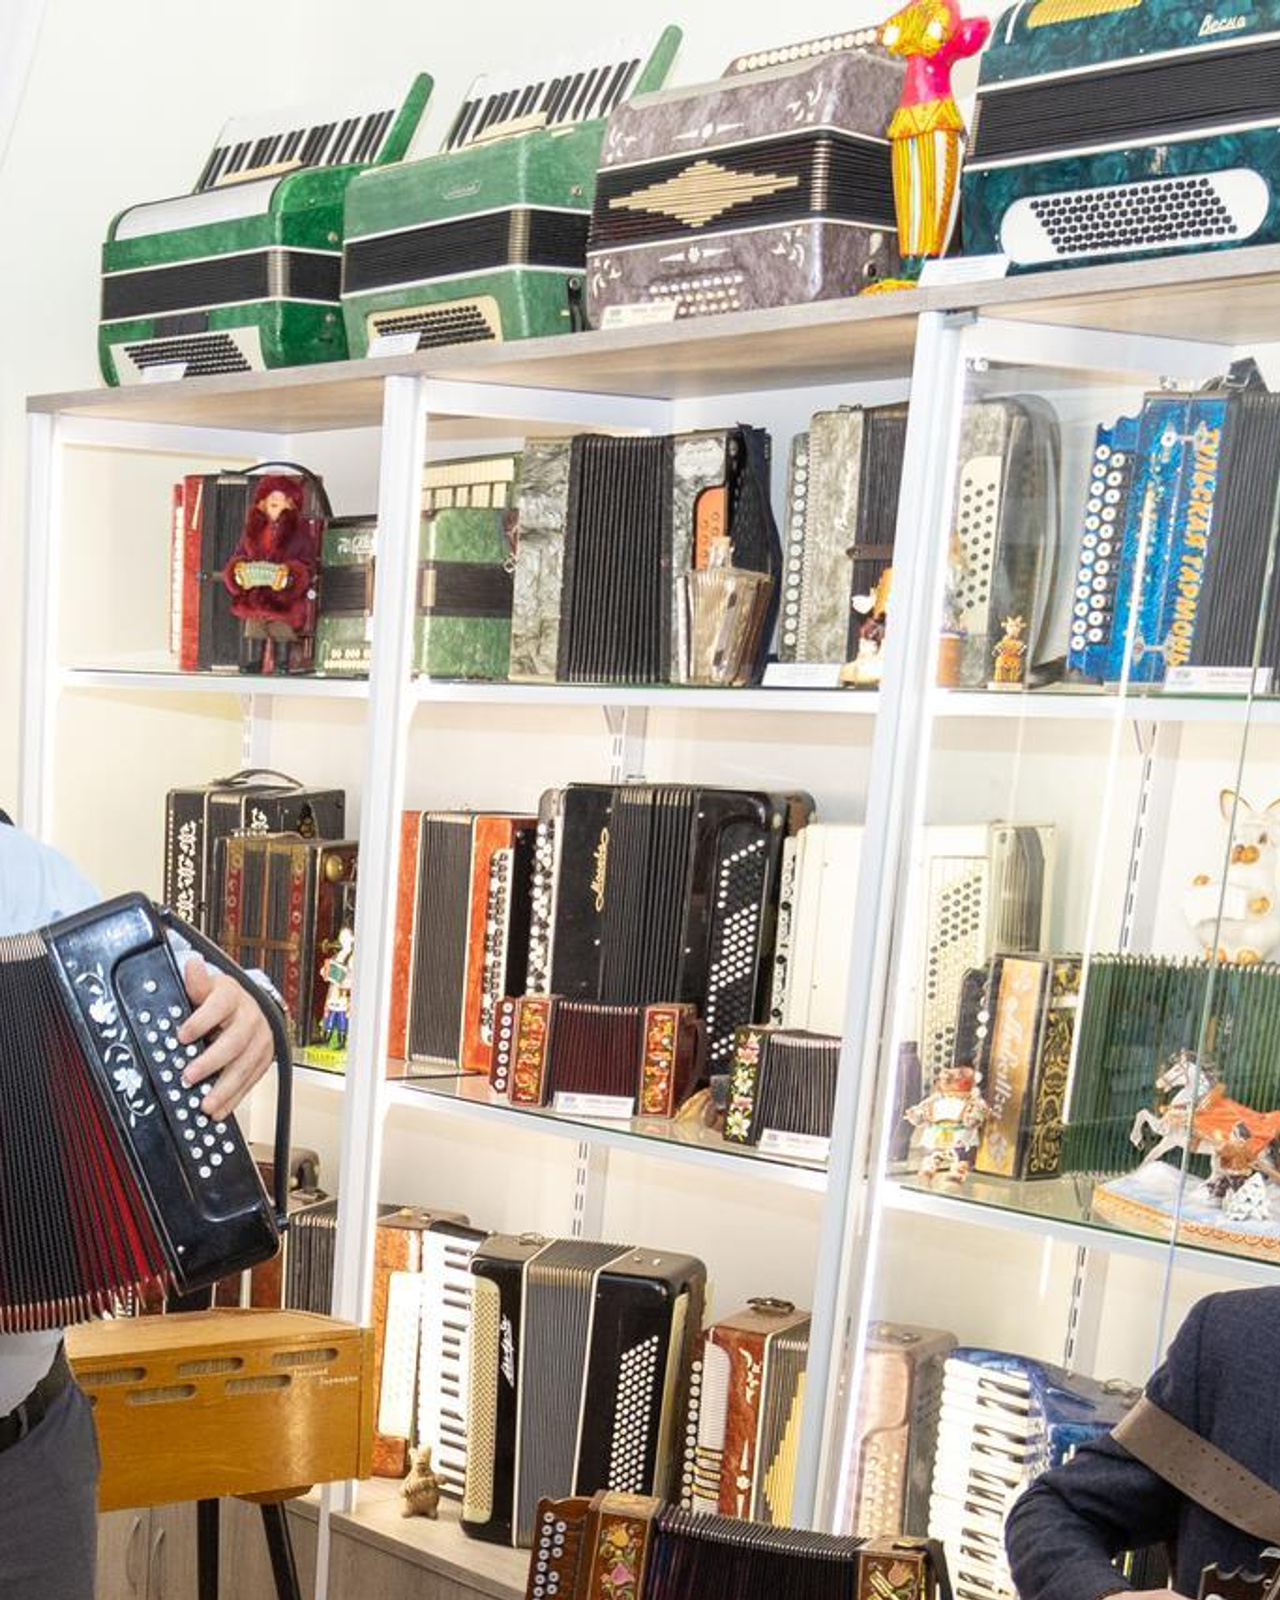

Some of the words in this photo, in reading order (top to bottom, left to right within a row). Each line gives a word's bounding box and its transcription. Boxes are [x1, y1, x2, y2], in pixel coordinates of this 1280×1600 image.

[1198, 13, 1246, 37] Весна
[1185, 428, 1220, 548] ТУЛЬСКАЯ
[1167, 555, 1202, 667] ГАРМОНЬ
